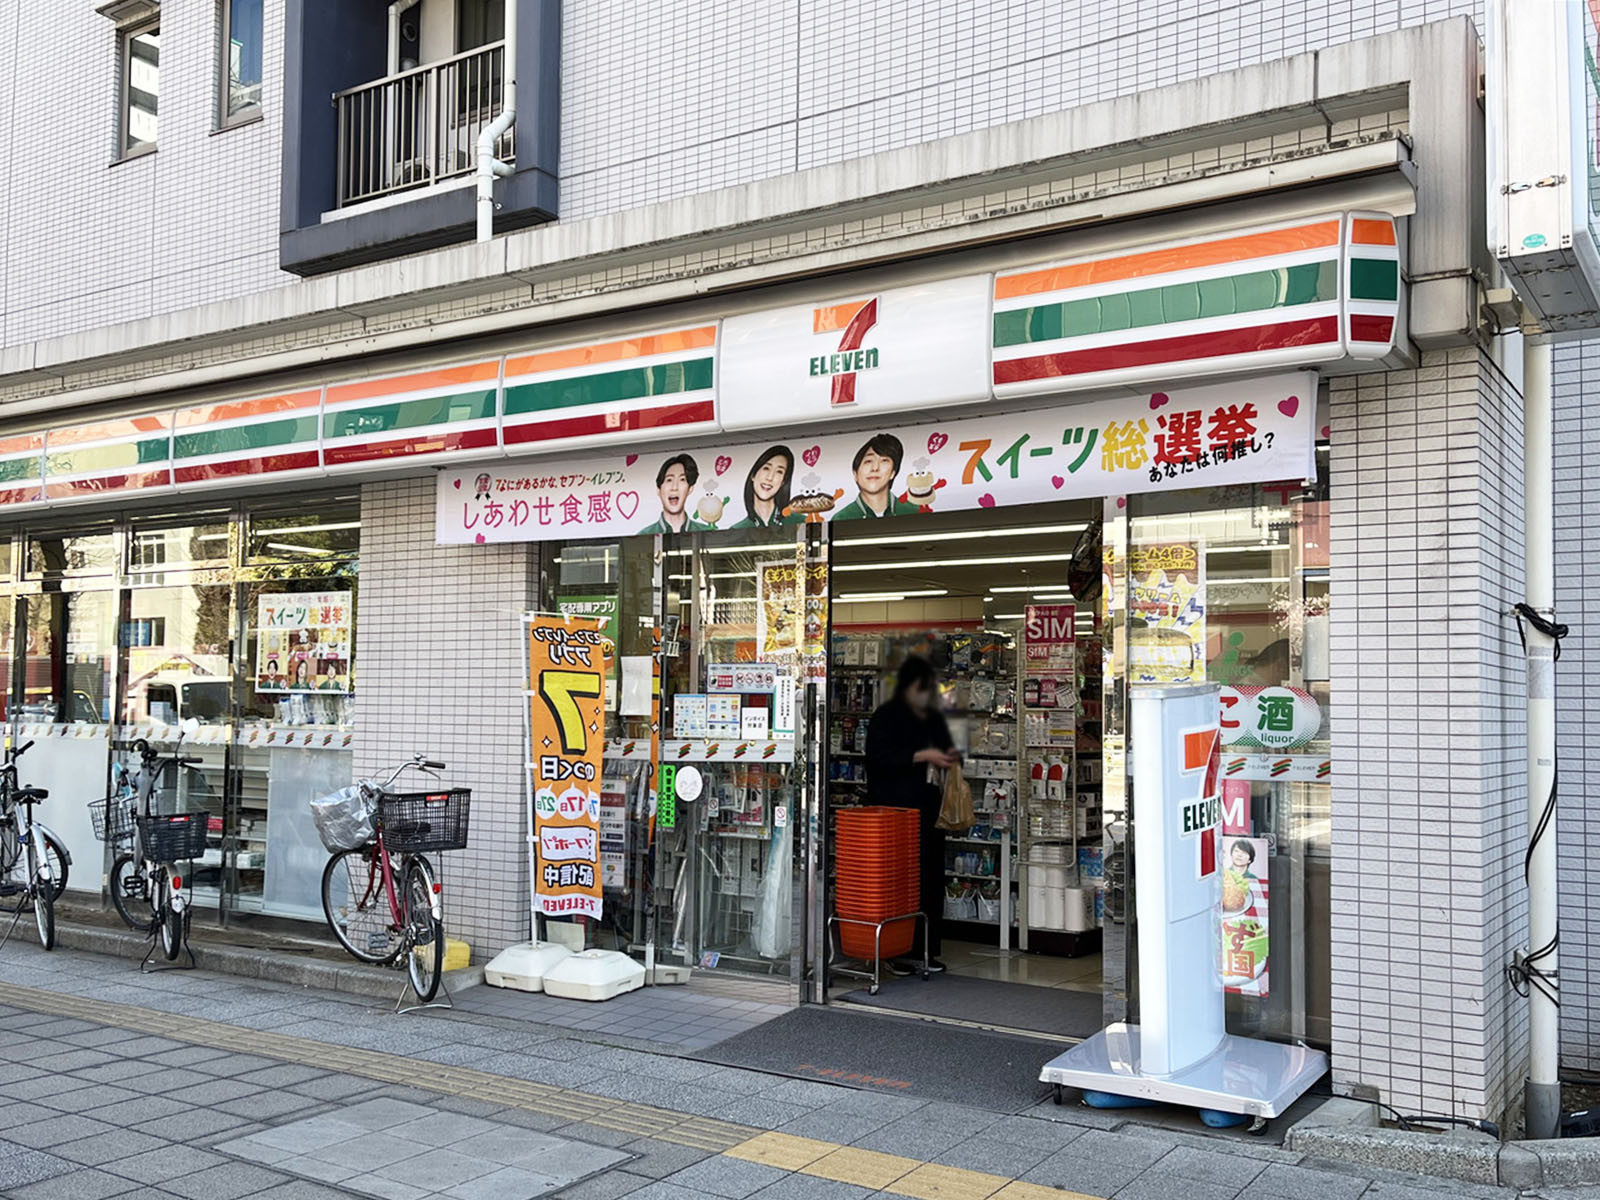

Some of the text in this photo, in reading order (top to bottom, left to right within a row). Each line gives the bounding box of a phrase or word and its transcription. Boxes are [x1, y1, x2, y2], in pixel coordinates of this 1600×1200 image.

[813, 297, 877, 404] 7
[958, 403, 1258, 484] スイーツ総選挙
[1028, 617, 1072, 639] SIM
[1028, 647, 1048, 657] SIM
[1257, 695, 1295, 732] 酒
[1260, 731, 1295, 744] liquor
